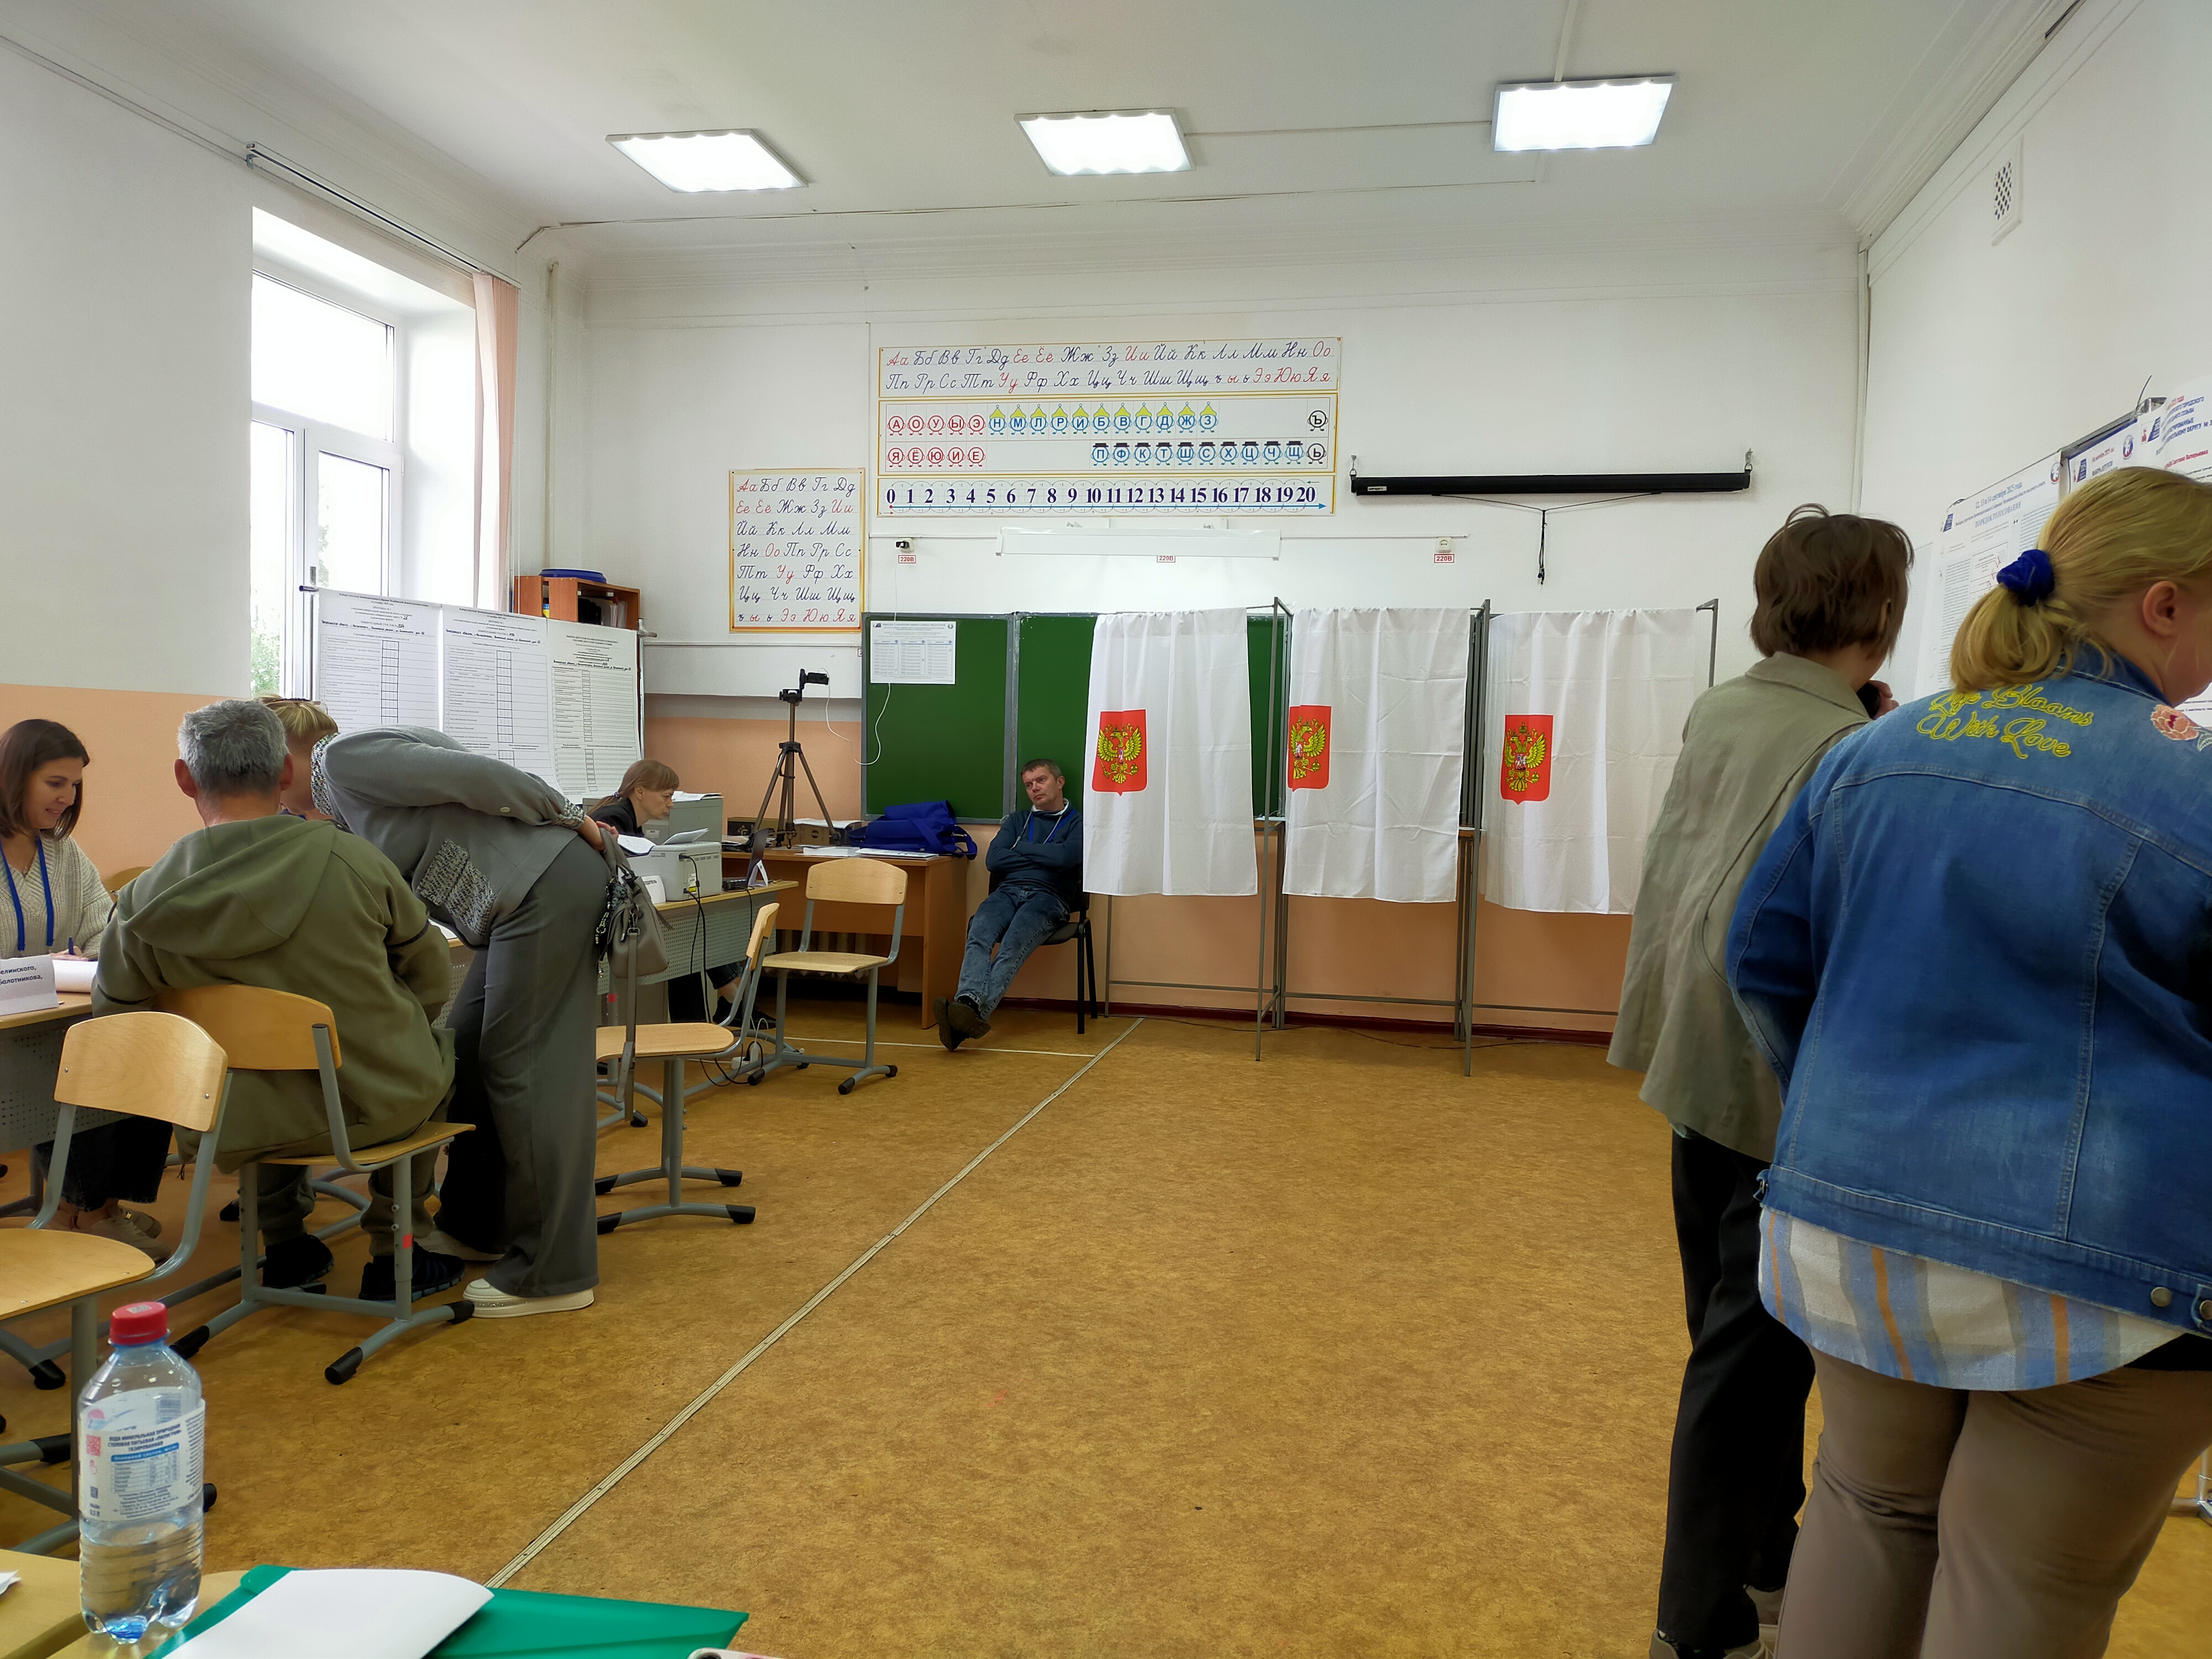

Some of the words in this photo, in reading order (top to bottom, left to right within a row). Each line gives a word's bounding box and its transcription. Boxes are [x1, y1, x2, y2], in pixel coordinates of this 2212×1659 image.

[887, 352, 909, 366] Аа
[914, 350, 938, 365] Бб
[938, 350, 960, 364] Вв
[966, 349, 983, 364] Гг
[987, 349, 1009, 371] Дд
[1014, 349, 1029, 363] Ее
[1036, 346, 1053, 362] Ёё
[1061, 347, 1094, 362] Жж
[1102, 346, 1118, 367] Зз
[1125, 346, 1149, 361] Ии
[1154, 343, 1177, 360] Йй
[1184, 345, 1206, 359] Кк
[1213, 344, 1239, 359] Лл
[1243, 343, 1277, 358] Мм
[1282, 342, 1307, 357] Нн
[1313, 341, 1331, 357] Оо
[886, 374, 909, 389] Пп
[915, 374, 935, 394] Рр
[940, 373, 956, 388] Сс
[961, 374, 994, 388] Тт
[999, 373, 1018, 394] Уу
[1024, 372, 1047, 393] Фф
[1054, 371, 1079, 387] Хх
[1088, 370, 1112, 389] Цц
[1117, 371, 1137, 385] Чч
[1144, 371, 1172, 385] Шш
[1177, 369, 1209, 388] Щщ
[1215, 375, 1222, 383] ъ
[1253, 368, 1270, 383] Ээ
[1274, 367, 1301, 382] Юю
[1303, 367, 1330, 382] Яя
[893, 420, 900, 429] А
[912, 420, 920, 429] О
[933, 419, 940, 428] У
[951, 419, 961, 428] Ы
[973, 419, 980, 428] Э
[994, 419, 1000, 427] Н
[1014, 418, 1022, 427] М
[1035, 418, 1042, 427] Л
[1057, 418, 1064, 427] Р
[1077, 416, 1084, 427] Й
[1098, 417, 1105, 426] Б
[1120, 417, 1128, 426] В
[1141, 416, 1147, 426] Г
[1160, 416, 1168, 427] Д
[1181, 416, 1191, 425] Ж
[1204, 415, 1211, 425] З
[1312, 415, 1322, 425] Ъ
[892, 452, 899, 461] Я
[912, 450, 919, 461] Ё
[931, 451, 941, 461] Ю
[953, 452, 959, 460] И
[973, 452, 979, 460] Е
[1097, 450, 1104, 458] П
[1117, 450, 1126, 458] Ф
[1140, 450, 1146, 458] К
[1161, 449, 1167, 458] Т
[1180, 449, 1191, 458] Ш
[1203, 448, 1210, 458] С
[1224, 448, 1232, 458] Х
[1245, 448, 1253, 459] Ц
[1268, 448, 1275, 457] Ч
[1289, 447, 1300, 457] Щ
[1313, 448, 1321, 457] Ь
[737, 479, 758, 492] Аа
[760, 478, 784, 492] Бб
[786, 478, 806, 491] Вв
[812, 477, 828, 491] Гг
[833, 477, 855, 497] Дд
[887, 489, 895, 503] 0
[907, 489, 914, 503] 1
[925, 489, 933, 503] 2
[946, 489, 955, 503] 3
[966, 489, 975, 503] 4
[987, 489, 995, 503] 5
[1007, 488, 1015, 503] 6
[1027, 489, 1036, 503] 7
[1047, 488, 1056, 503] 8
[1068, 488, 1077, 503] 9
[1086, 488, 1101, 503] 10
[1106, 488, 1122, 503] 11
[1126, 488, 1143, 503] 12
[1147, 488, 1164, 503] 13
[1170, 488, 1185, 503] 14
[1190, 488, 1206, 503] 15
[1211, 487, 1228, 503] 16
[1233, 488, 1249, 502] 17
[1254, 487, 1271, 502] 18
[1276, 487, 1293, 502] 19
[1296, 487, 1315, 502] 20
[737, 500, 750, 513] Ее
[756, 499, 771, 513] Ёё
[777, 499, 806, 513] Жж
[811, 499, 827, 518] Зз
[832, 499, 853, 513] Ии
[737, 521, 758, 535] Йй
[766, 521, 785, 535] Кк
[792, 521, 814, 535] Лл
[820, 521, 850, 535] Мм
[737, 543, 759, 557] Нн
[765, 543, 780, 557] Оо
[784, 542, 805, 557] Пп
[810, 543, 830, 562] Рр
[836, 543, 851, 556] Сс
[737, 565, 768, 578] Тт
[777, 565, 794, 584] Уу
[803, 565, 823, 584] Фф
[831, 565, 853, 578] Хх
[740, 586, 761, 603] Цц
[770, 587, 788, 600] Чч
[796, 587, 821, 600] Шш
[827, 587, 855, 603] Щщ
[781, 608, 796, 622] Ээ
[803, 608, 828, 622] Юю
[833, 608, 856, 622] Яя
[1981, 684, 2094, 726] Blooms
[1917, 711, 2000, 740] With
[2000, 718, 2072, 759] Love
[0, 966, 36, 975] елинского,
